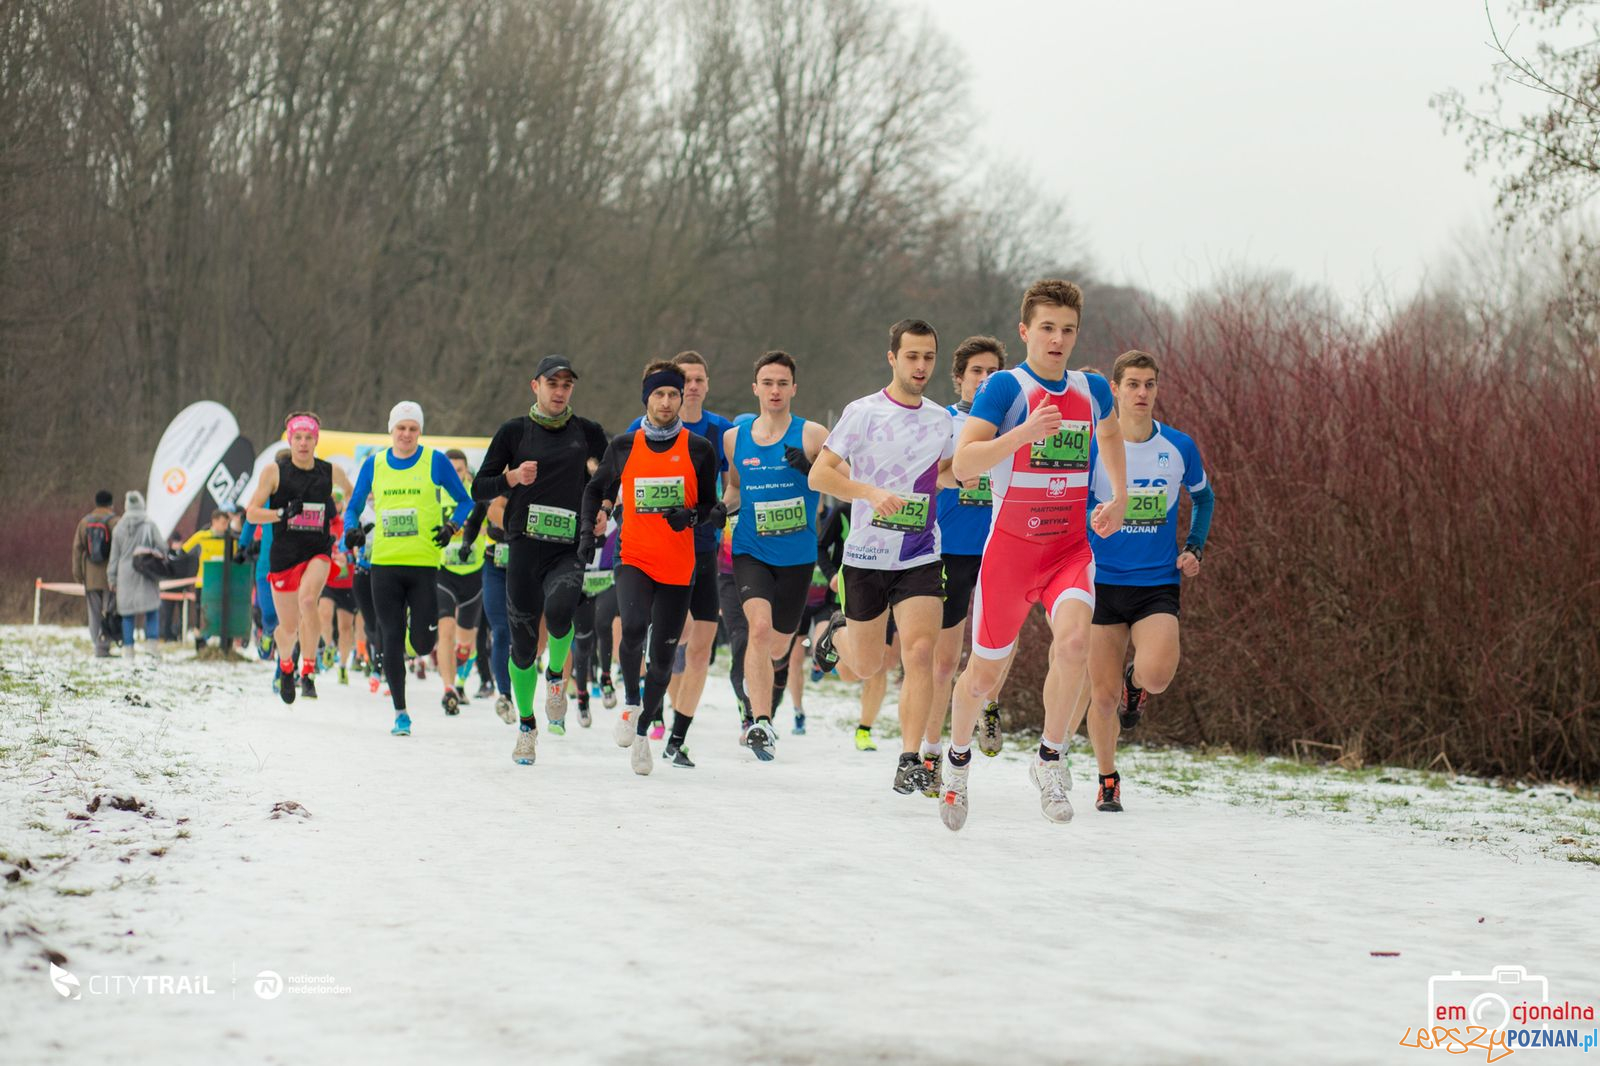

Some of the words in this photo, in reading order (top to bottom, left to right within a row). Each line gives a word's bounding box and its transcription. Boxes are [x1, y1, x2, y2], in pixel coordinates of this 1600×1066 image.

[1053, 431, 1084, 450] 840
[383, 488, 406, 496] NOWAK
[651, 486, 678, 499] 295
[1132, 496, 1159, 511] 261
[392, 515, 413, 526] 309
[544, 514, 570, 529] 683
[768, 506, 803, 523] 1600
